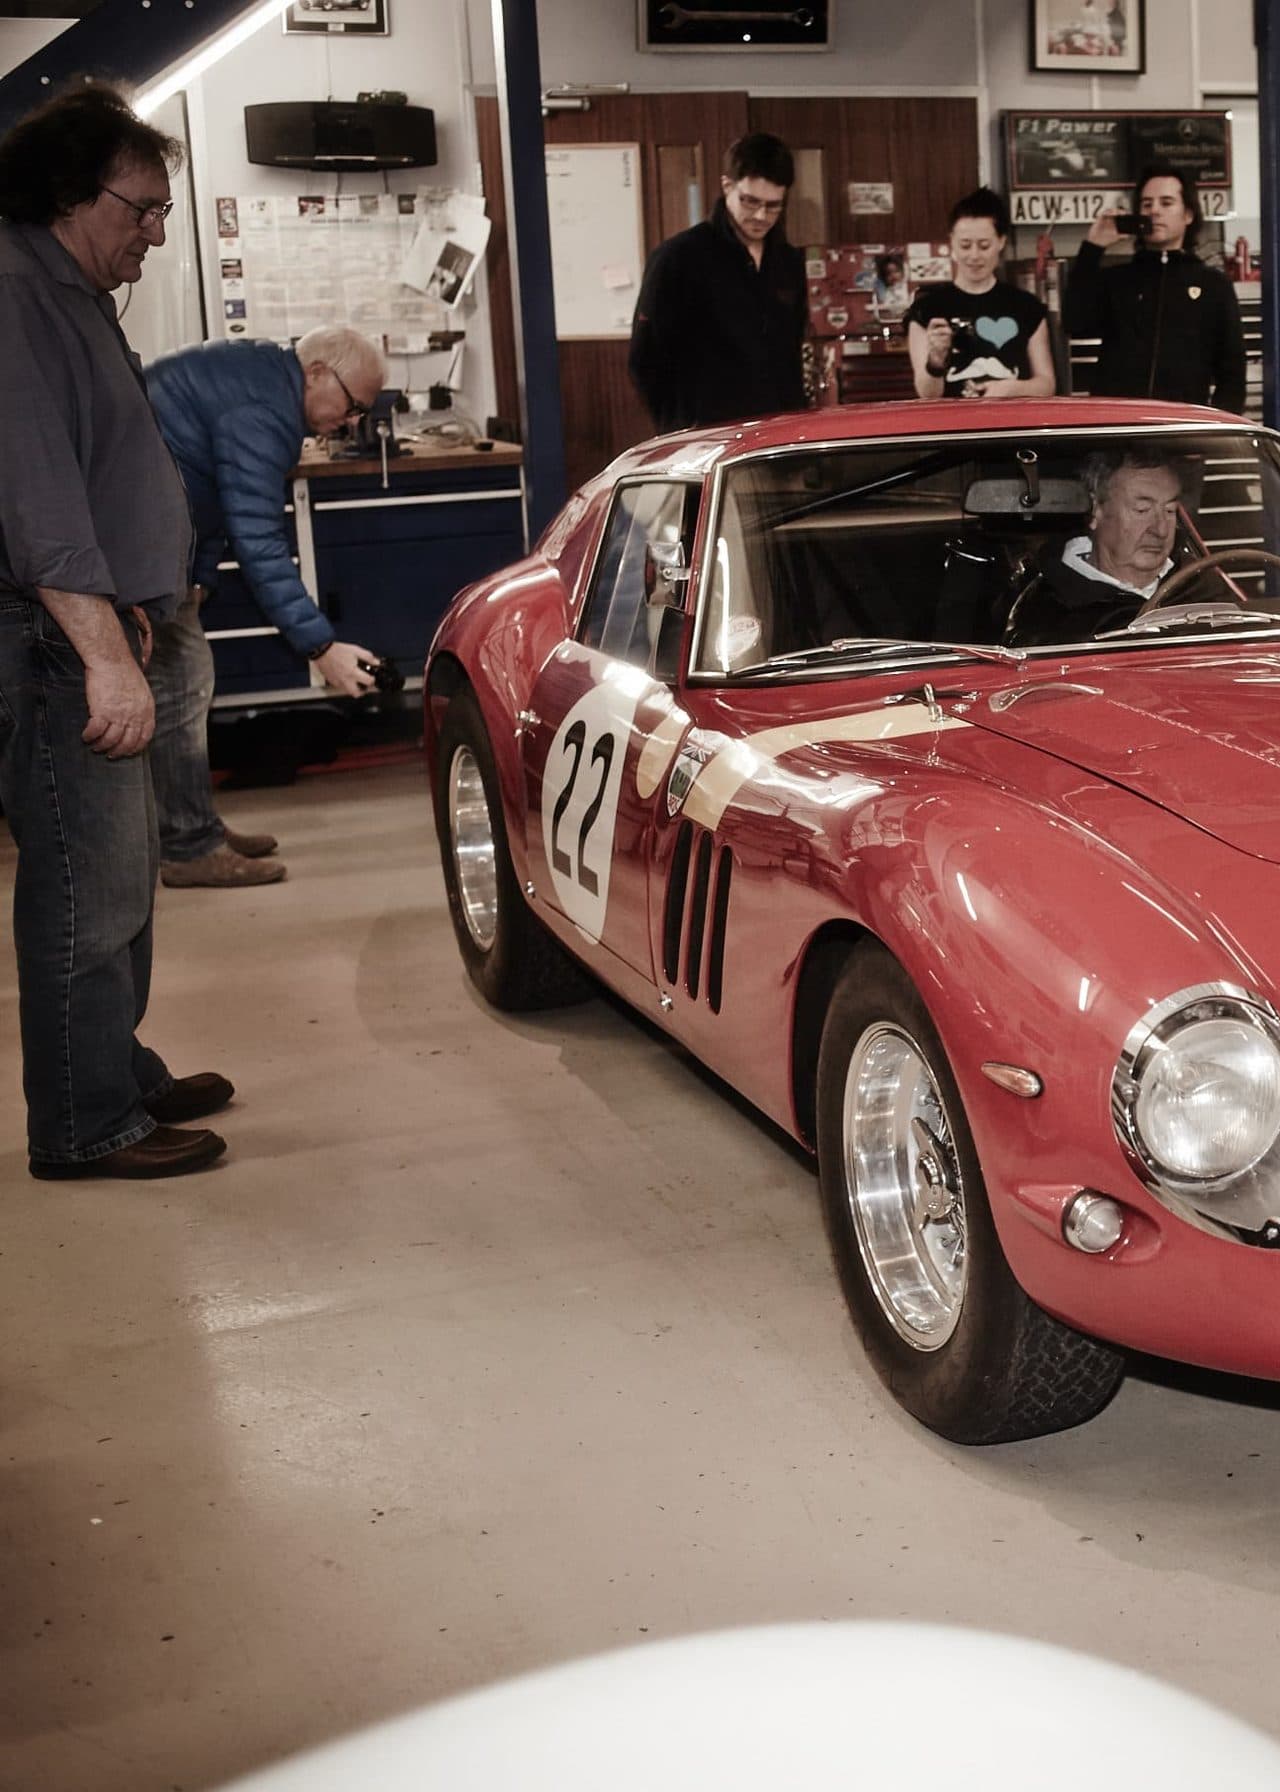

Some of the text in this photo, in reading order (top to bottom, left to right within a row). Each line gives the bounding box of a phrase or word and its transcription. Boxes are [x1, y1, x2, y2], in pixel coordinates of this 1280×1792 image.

[1017, 118, 1117, 133] F1 Power
[1014, 194, 1104, 220] ACW-112
[551, 719, 615, 898] 22
